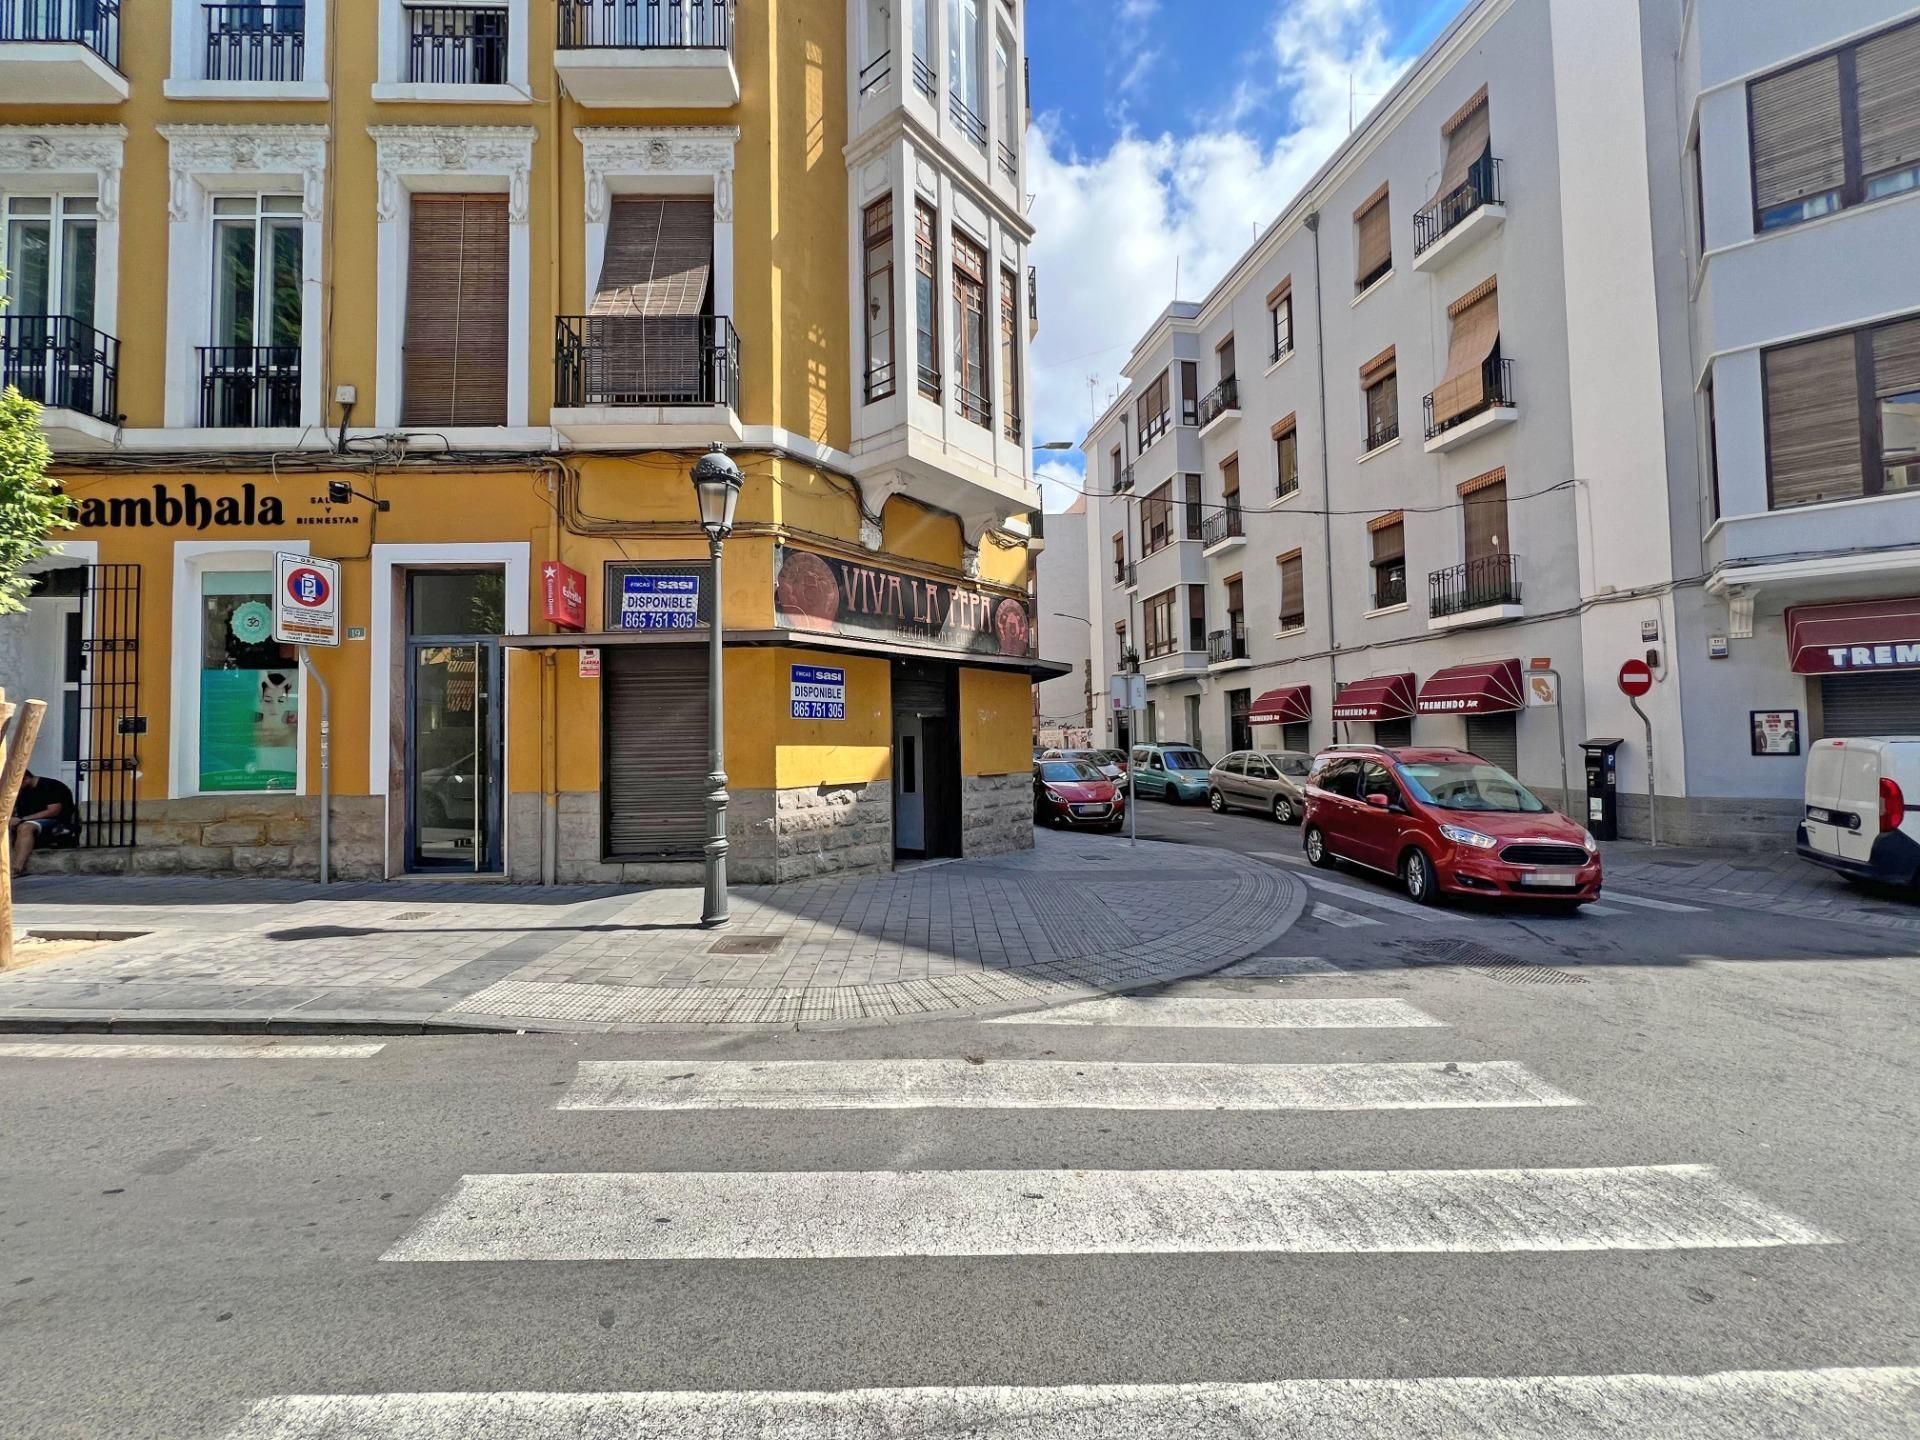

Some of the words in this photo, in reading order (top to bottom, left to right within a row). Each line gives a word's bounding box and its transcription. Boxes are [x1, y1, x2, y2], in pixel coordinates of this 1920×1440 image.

[297, 517, 359, 525] BIENESTAR
[841, 565, 905, 620] VIVA
[911, 580, 942, 623] LA
[627, 597, 692, 608] DISPONIBLE
[625, 612, 646, 628] 865
[649, 612, 669, 628] 751
[672, 613, 693, 628] 305
[1827, 644, 1920, 666] TREM
[794, 685, 842, 699] DISPONIBLE
[793, 701, 810, 717] 865
[811, 702, 826, 718] 751
[828, 703, 843, 718] 305
[1418, 699, 1464, 710] TREMENDO
[1333, 708, 1367, 717] TREMENDO
